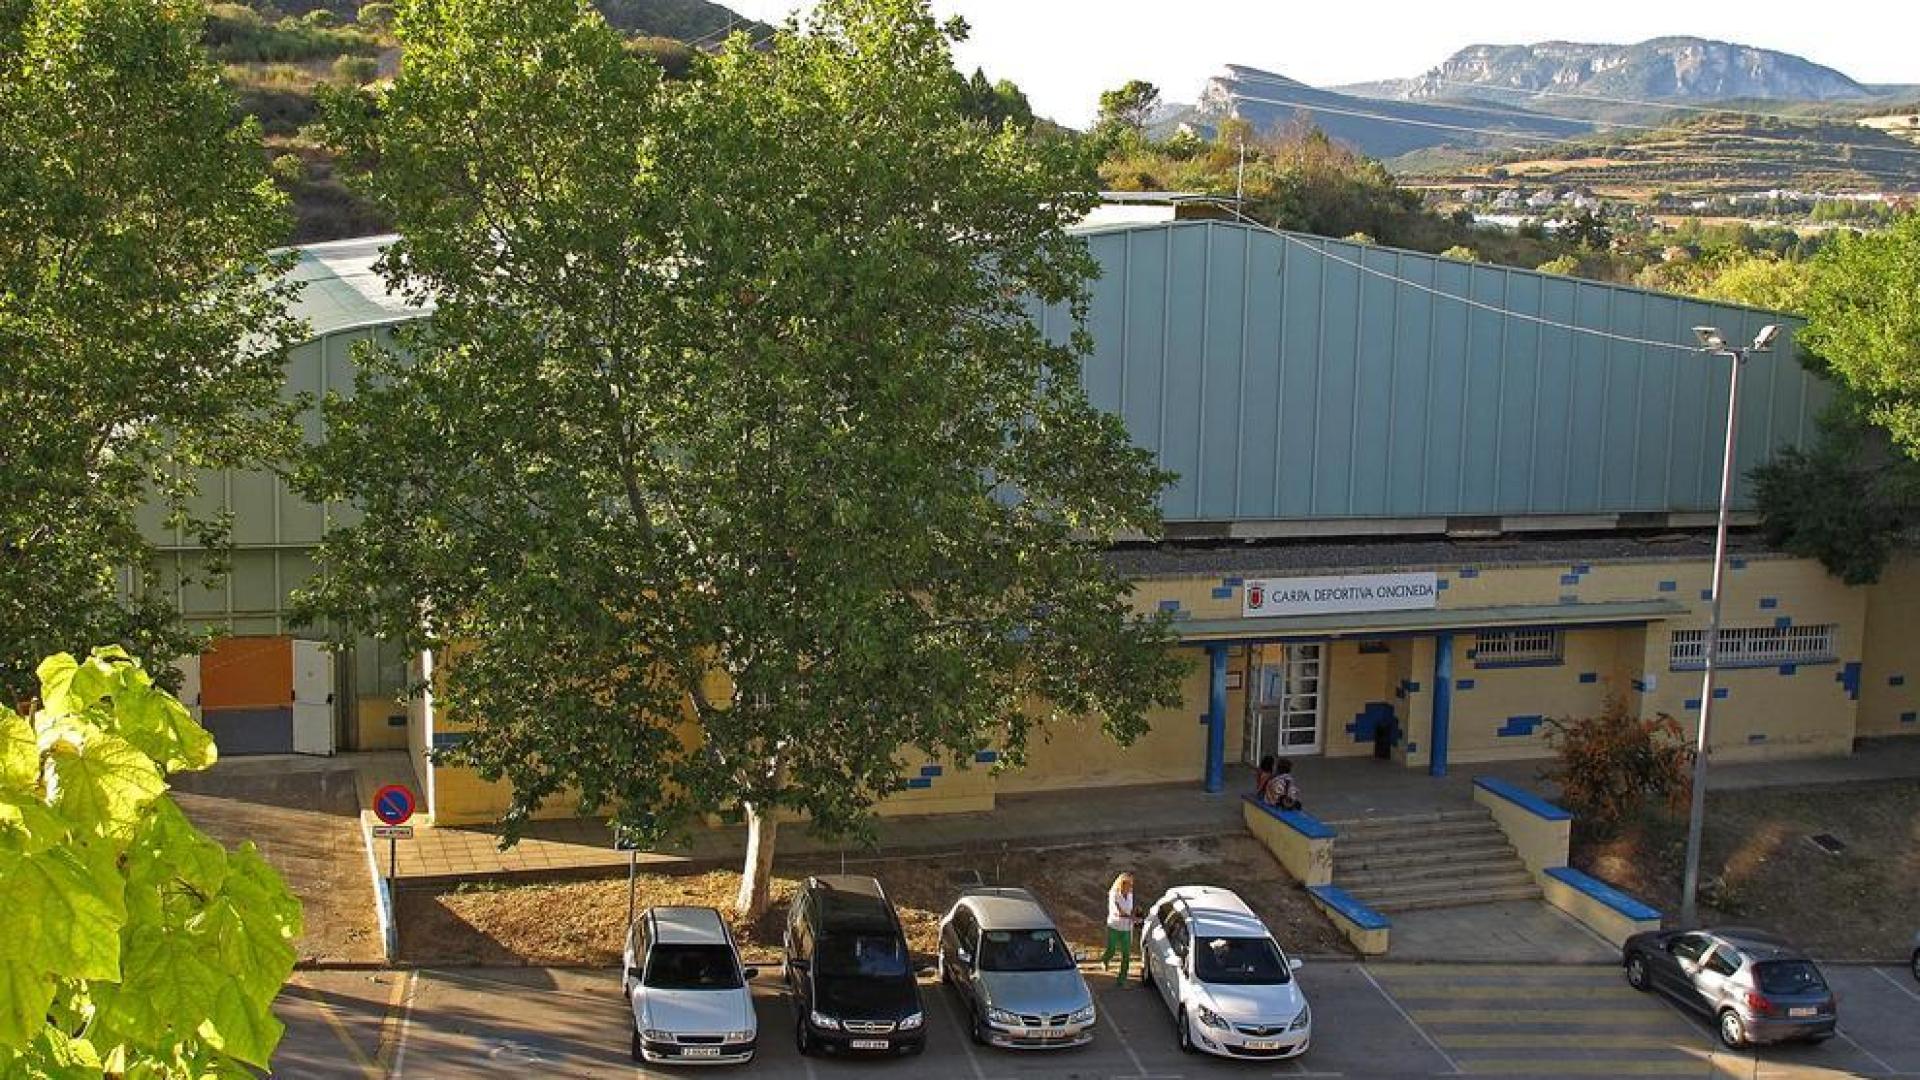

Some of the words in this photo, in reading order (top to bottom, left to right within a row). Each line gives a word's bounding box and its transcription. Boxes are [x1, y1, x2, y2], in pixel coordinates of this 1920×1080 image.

[1271, 590, 1311, 604] CARPA
[1314, 586, 1374, 602] DEPORTIVA
[1376, 583, 1434, 598] ONCINEDA
